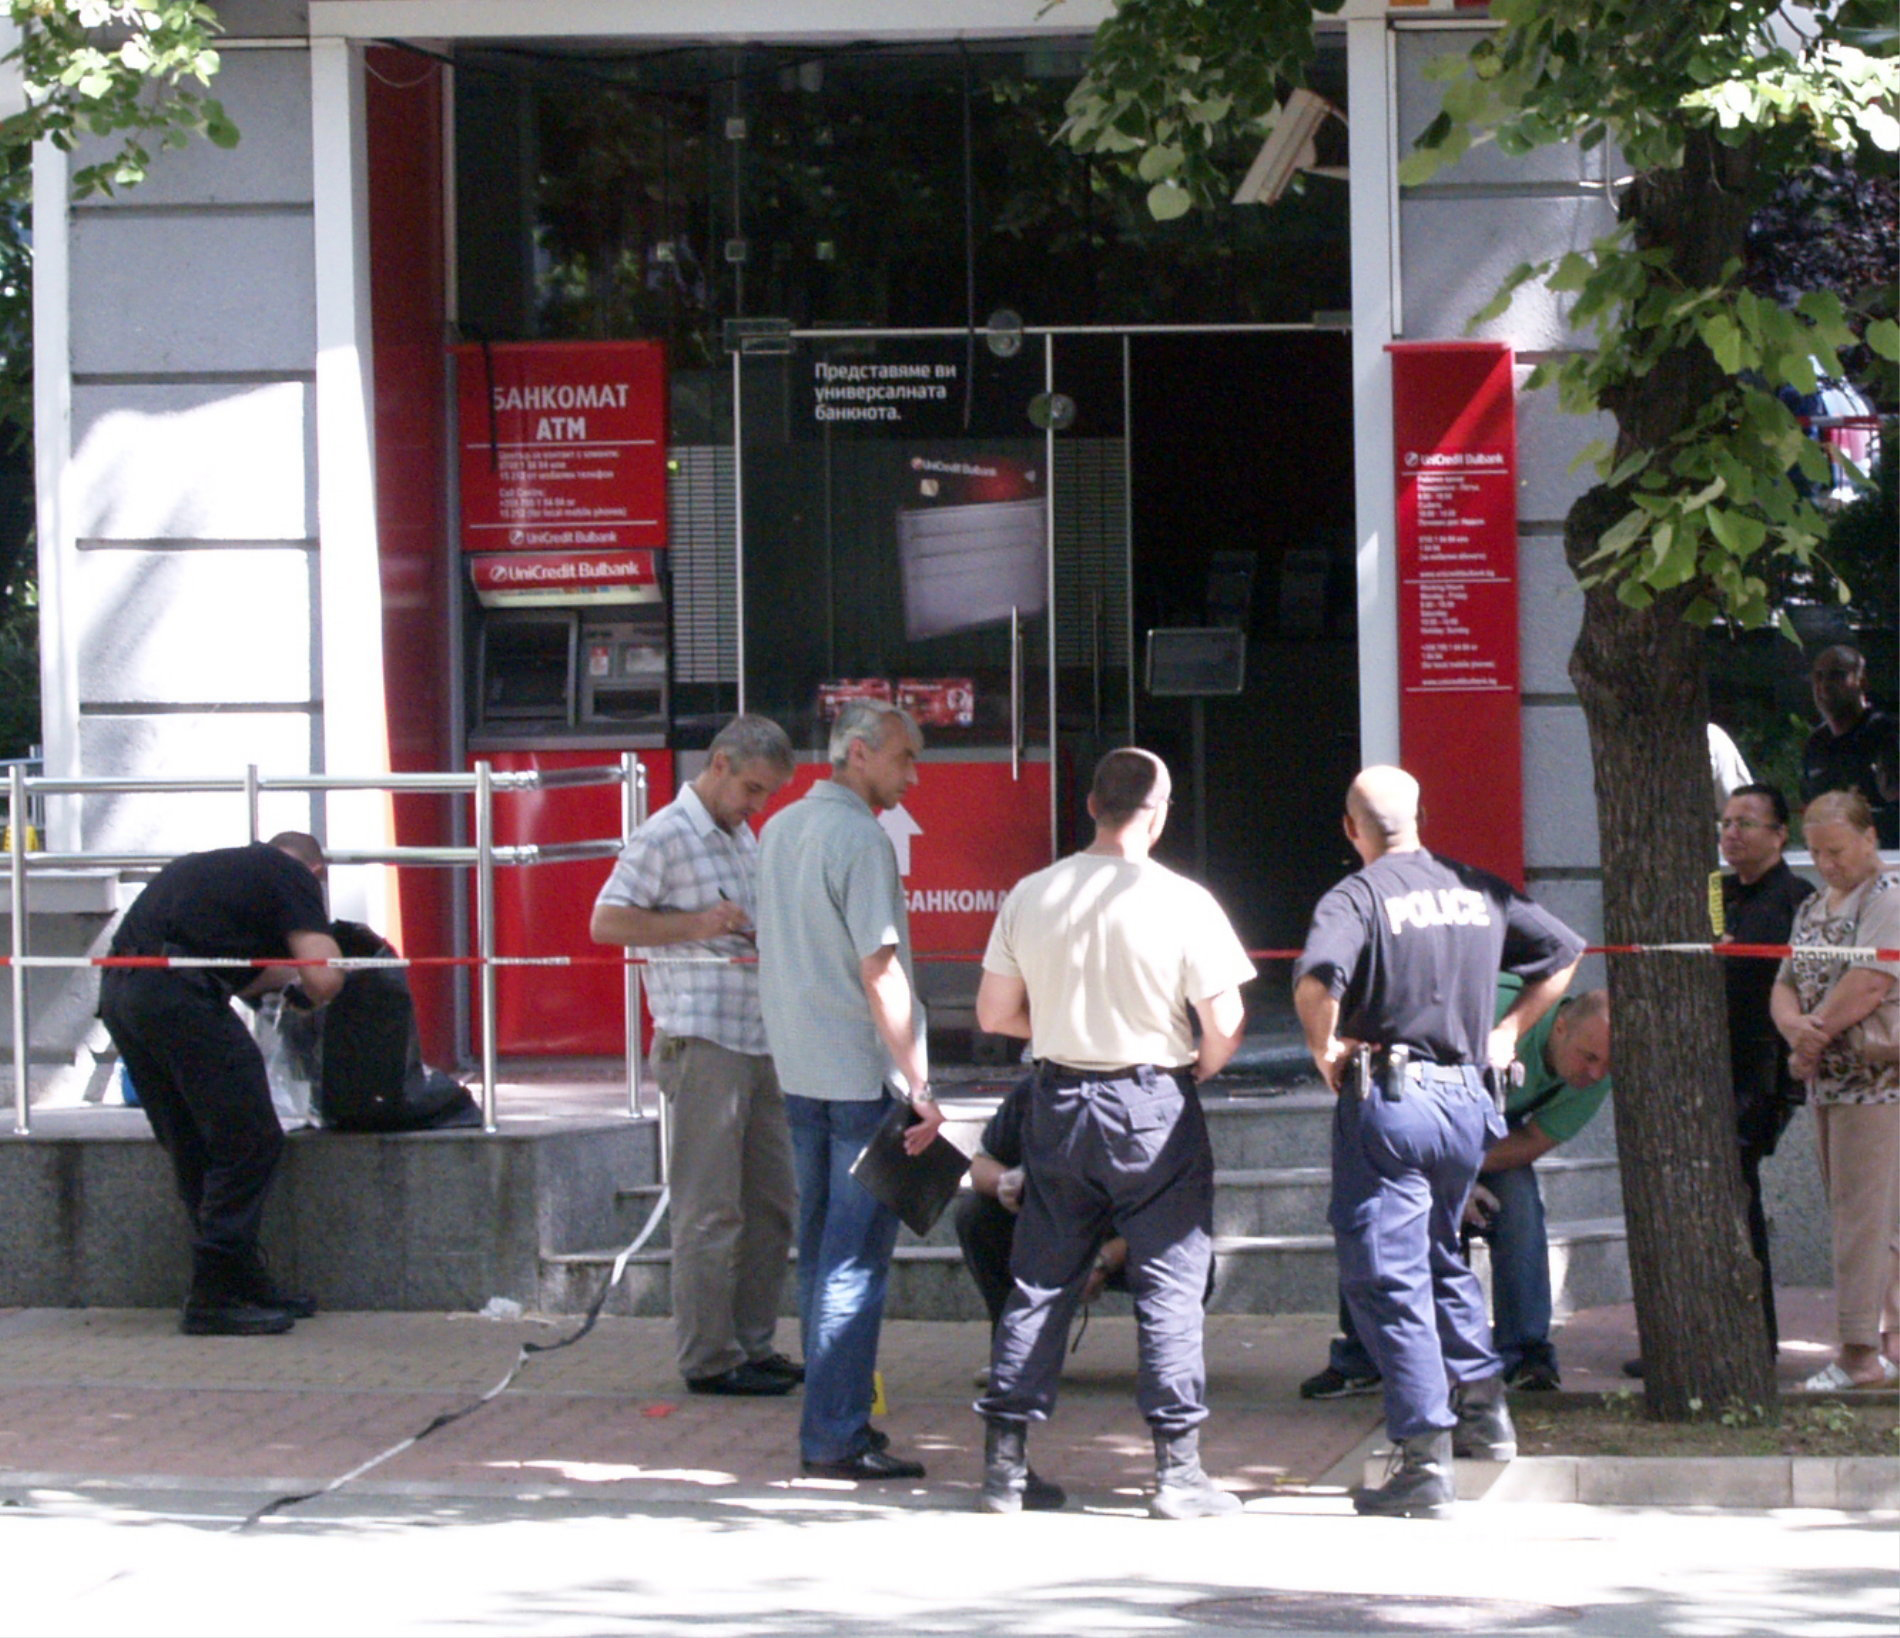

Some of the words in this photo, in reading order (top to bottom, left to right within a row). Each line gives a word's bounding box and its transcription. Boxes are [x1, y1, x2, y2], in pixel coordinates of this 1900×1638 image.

[815, 363, 930, 380] Представяме
[934, 364, 957, 378] ви
[493, 384, 629, 410] БАНКОМАТ
[815, 385, 947, 401] универсалната
[815, 404, 901, 420] банкнота.
[536, 416, 586, 440] ATM
[525, 531, 574, 545] UniCredit
[575, 530, 618, 543] Bulbank
[509, 563, 576, 581] UniCredit
[578, 561, 640, 578] Bulbank
[1385, 888, 1490, 935] POLICE
